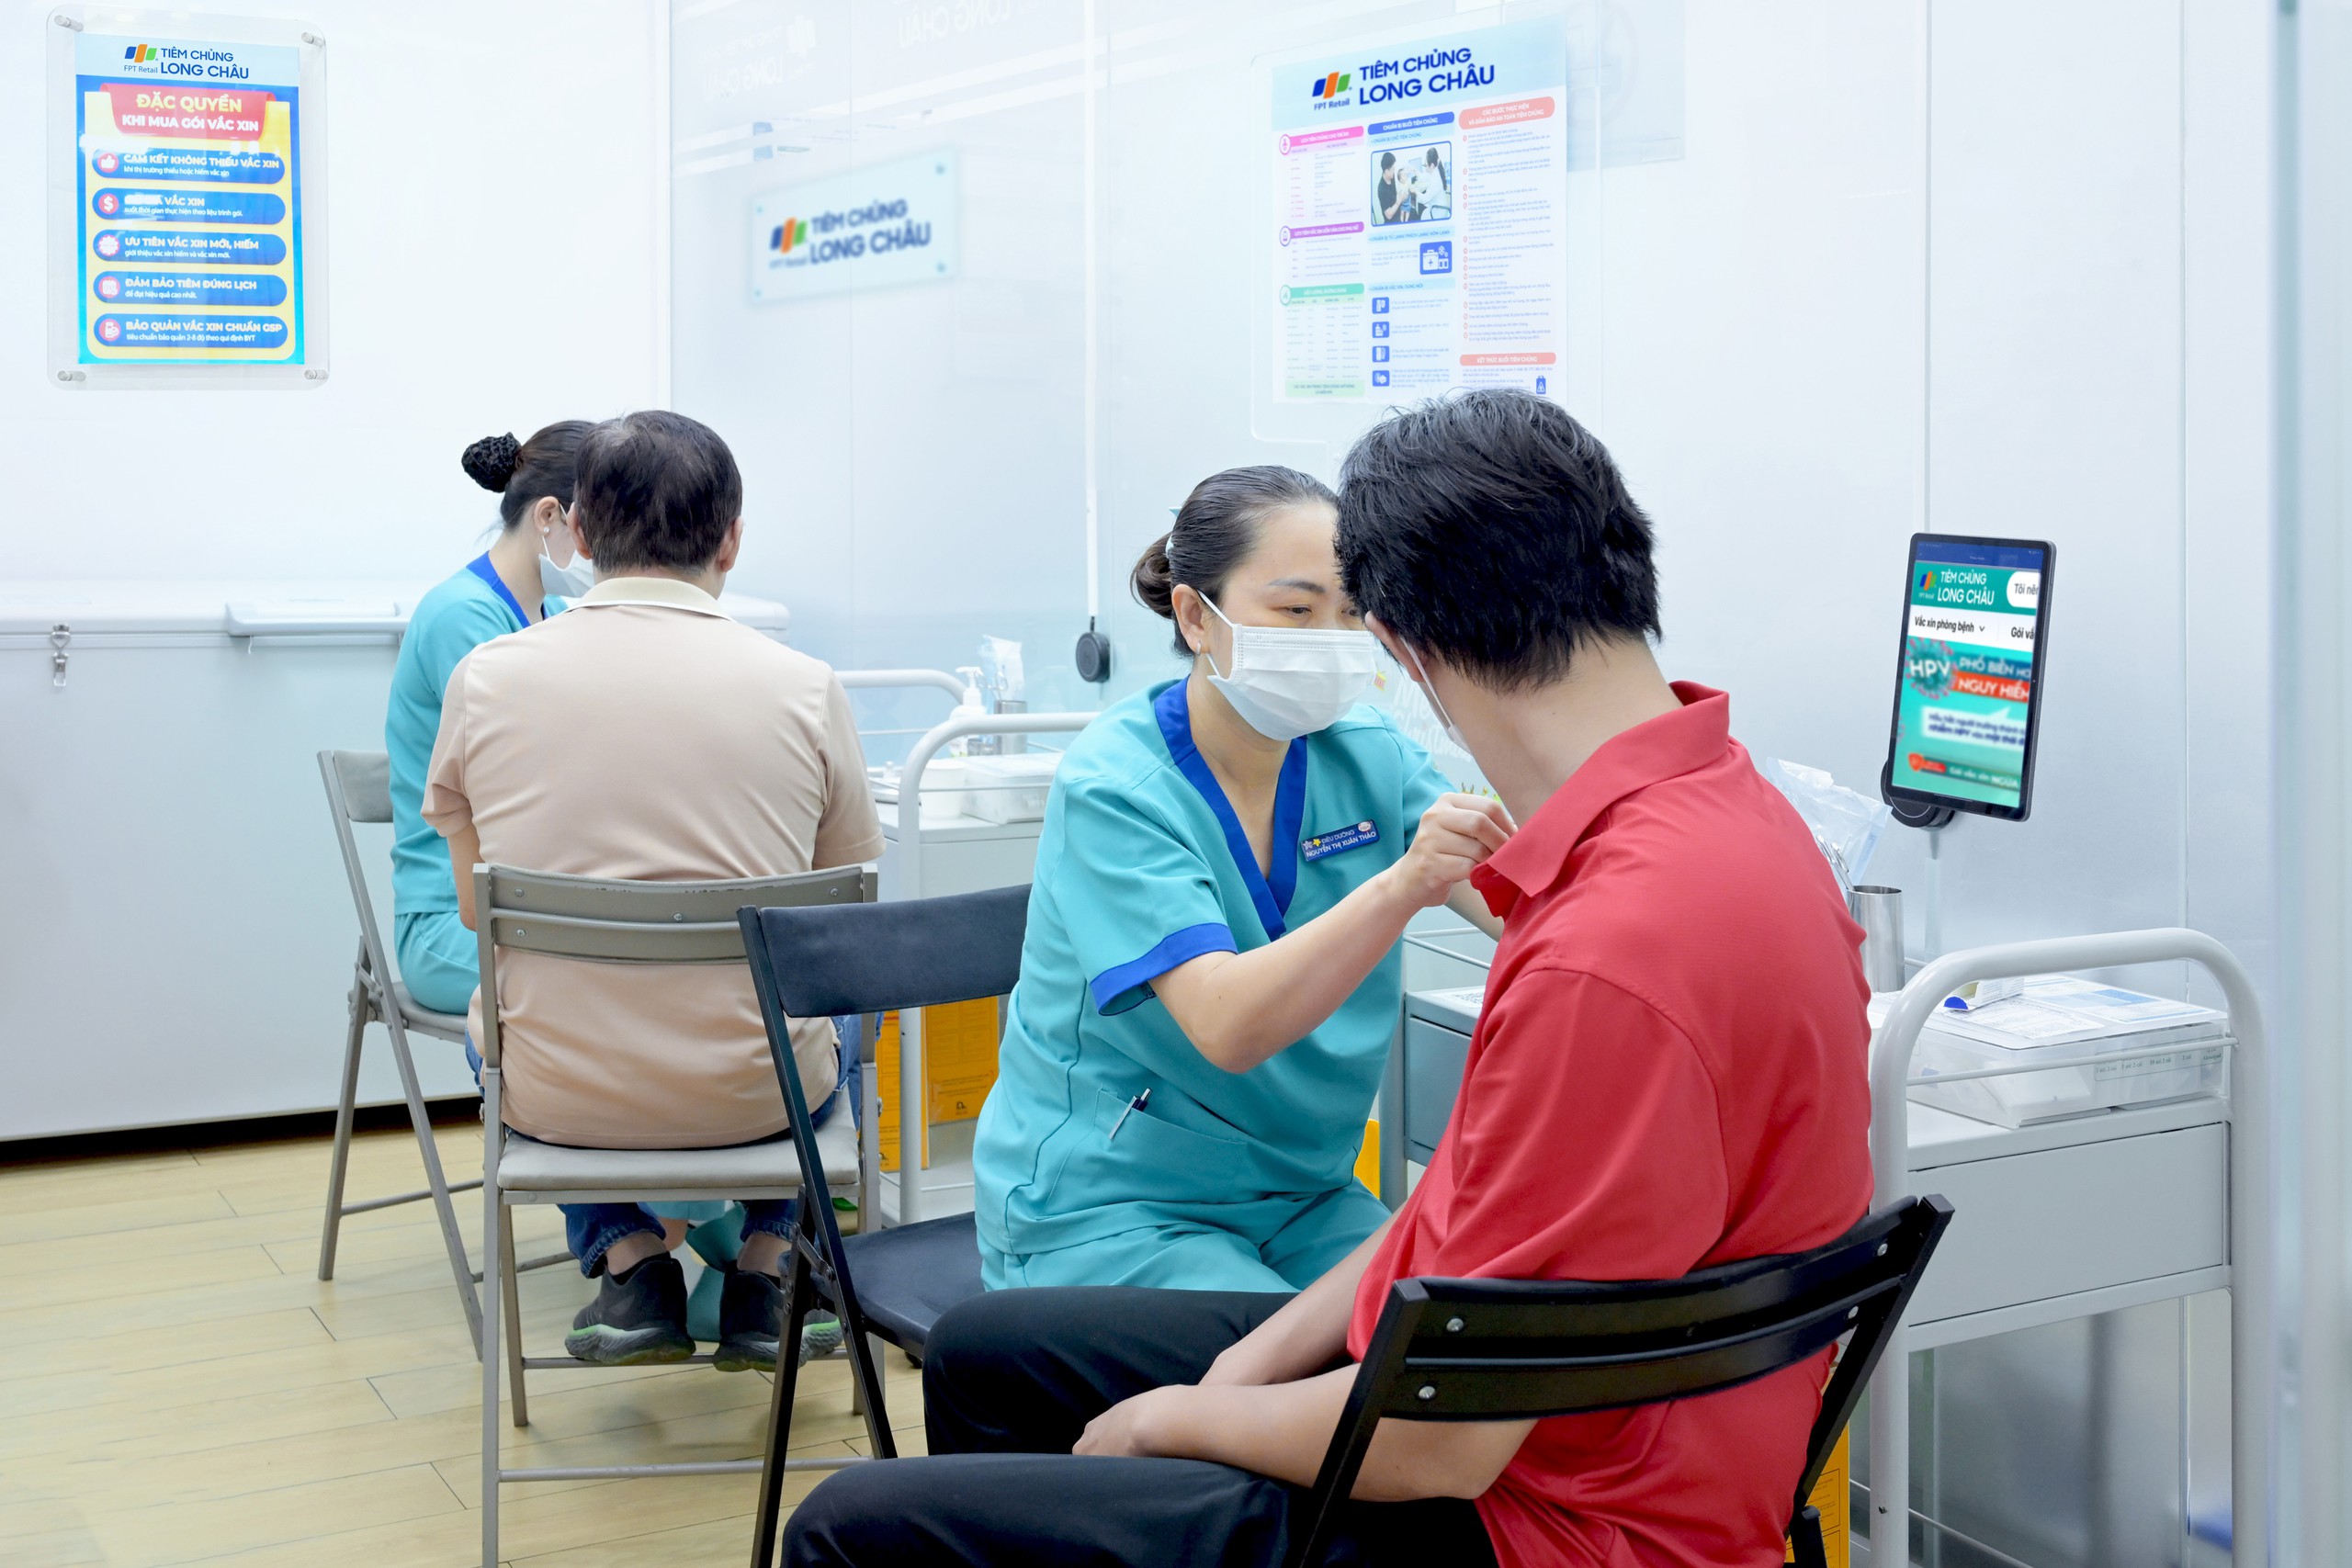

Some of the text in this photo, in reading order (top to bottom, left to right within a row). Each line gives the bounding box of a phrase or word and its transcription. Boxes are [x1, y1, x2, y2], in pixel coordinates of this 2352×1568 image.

[161, 46, 233, 62] TIÊM CHỦNG
[161, 62, 249, 79] LONG CHÂU
[1359, 48, 1472, 81] TIÊM CHỦNG
[1359, 62, 1495, 106] LONG CHÂU
[136, 91, 242, 113] ĐẶC QUYỀN
[1314, 98, 1350, 111] FPT Retail
[122, 115, 259, 131] KHI MUA GÓI VẮC XIN
[149, 153, 169, 164] KẾT
[171, 156, 207, 165] KHÔNG
[209, 156, 238, 167] THIẾU
[240, 157, 260, 167] VẮC
[263, 160, 279, 168] XIN
[164, 194, 186, 206] VẮC
[187, 197, 204, 206] XIN
[811, 198, 909, 234] TIÊM CHỦNG
[125, 235, 258, 250] ƯU TIÊN VẮC XIN MỚI, HIẾM
[810, 219, 932, 265] LONG CHÂU
[125, 276, 257, 291] ĐẢM BẢO TIÊM ĐÚNG LỊCH
[126, 319, 282, 333] BẢO QUẢN VẮC XIN CHUẨN GSP
[1940, 569, 1986, 584] TIÊM CHỦNG
[1938, 587, 1995, 605] LONG CHÂU
[2014, 583, 2025, 594] Tôi
[1915, 615, 1926, 626] Vắc
[1927, 617, 1936, 628] xin
[1958, 621, 1974, 634] bệnh
[2011, 626, 2024, 638] Gói
[1909, 659, 1951, 678] HPV
[1958, 678, 1998, 694] NGUY
